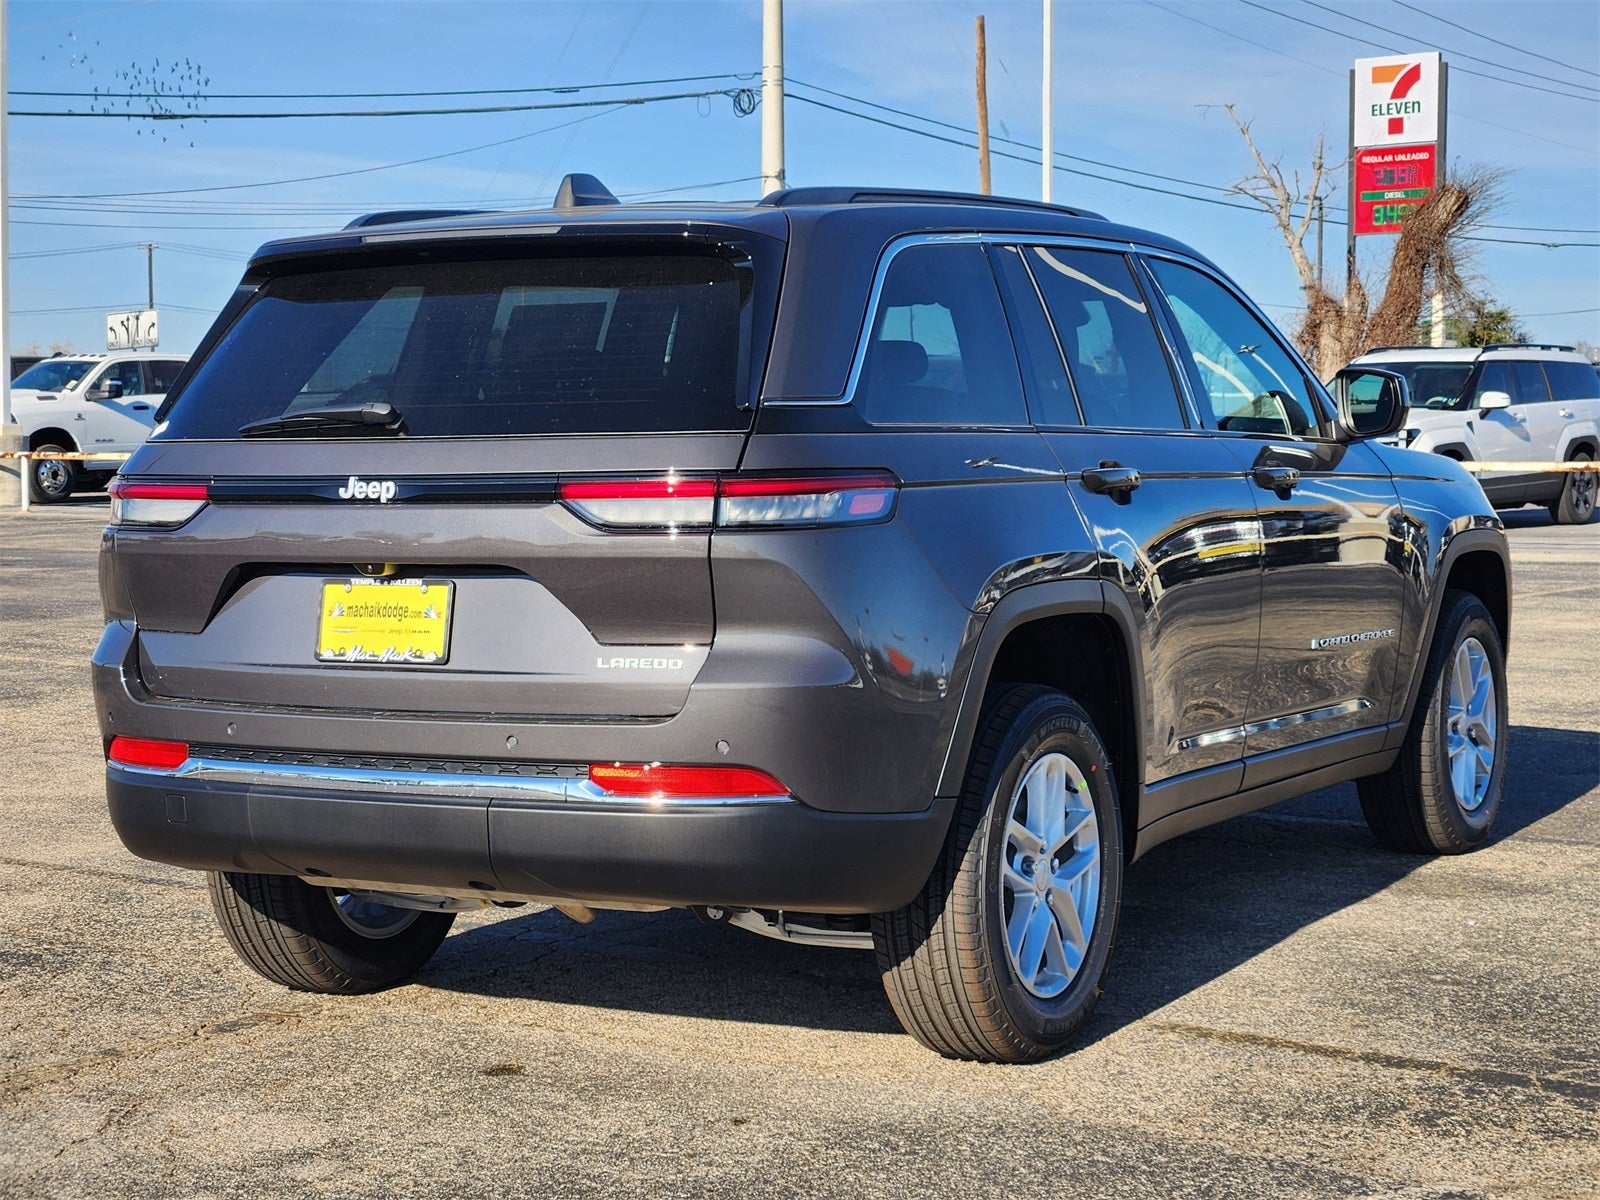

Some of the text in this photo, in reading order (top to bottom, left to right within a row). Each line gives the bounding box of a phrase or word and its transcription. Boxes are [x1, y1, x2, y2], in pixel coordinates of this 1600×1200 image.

[1371, 62, 1421, 135] 7
[1361, 152, 1430, 164] REGULAR UNLEADED
[1384, 190, 1407, 200] DIESEL
[338, 475, 396, 504] Jeep
[345, 601, 423, 622] machaikdodge.com
[1319, 628, 1396, 648] GRAND CHEROKEE
[596, 656, 684, 670] LAREDO
